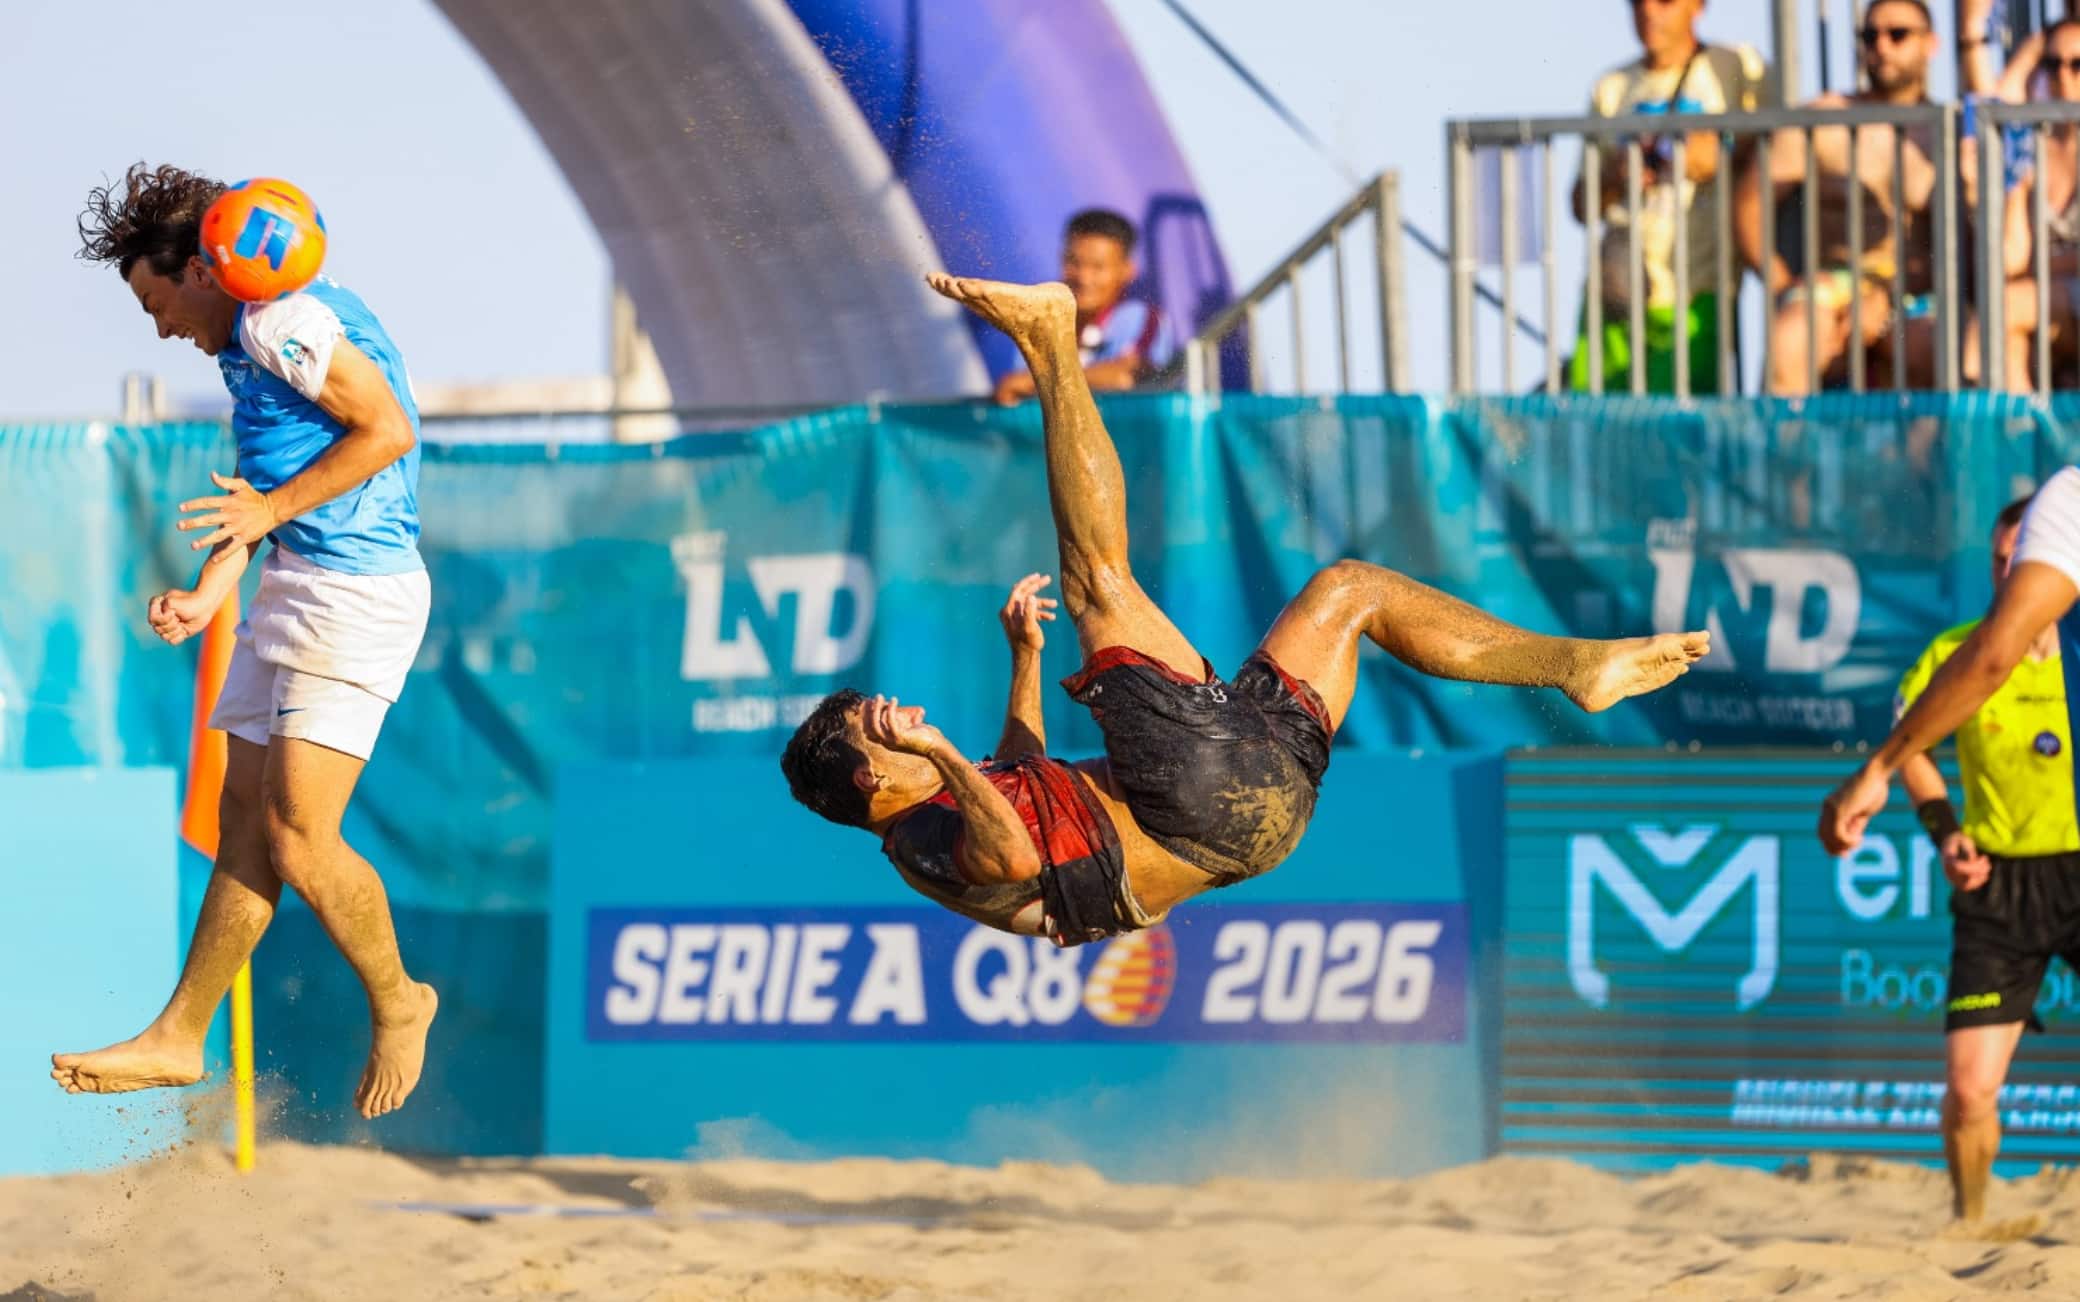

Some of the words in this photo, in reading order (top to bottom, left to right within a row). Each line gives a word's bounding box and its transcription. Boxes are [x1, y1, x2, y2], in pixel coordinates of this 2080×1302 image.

[604, 924, 852, 1025] SERIE
[848, 924, 927, 1025] A
[952, 926, 1085, 1027] Q8
[1202, 920, 1443, 1024] 2026
